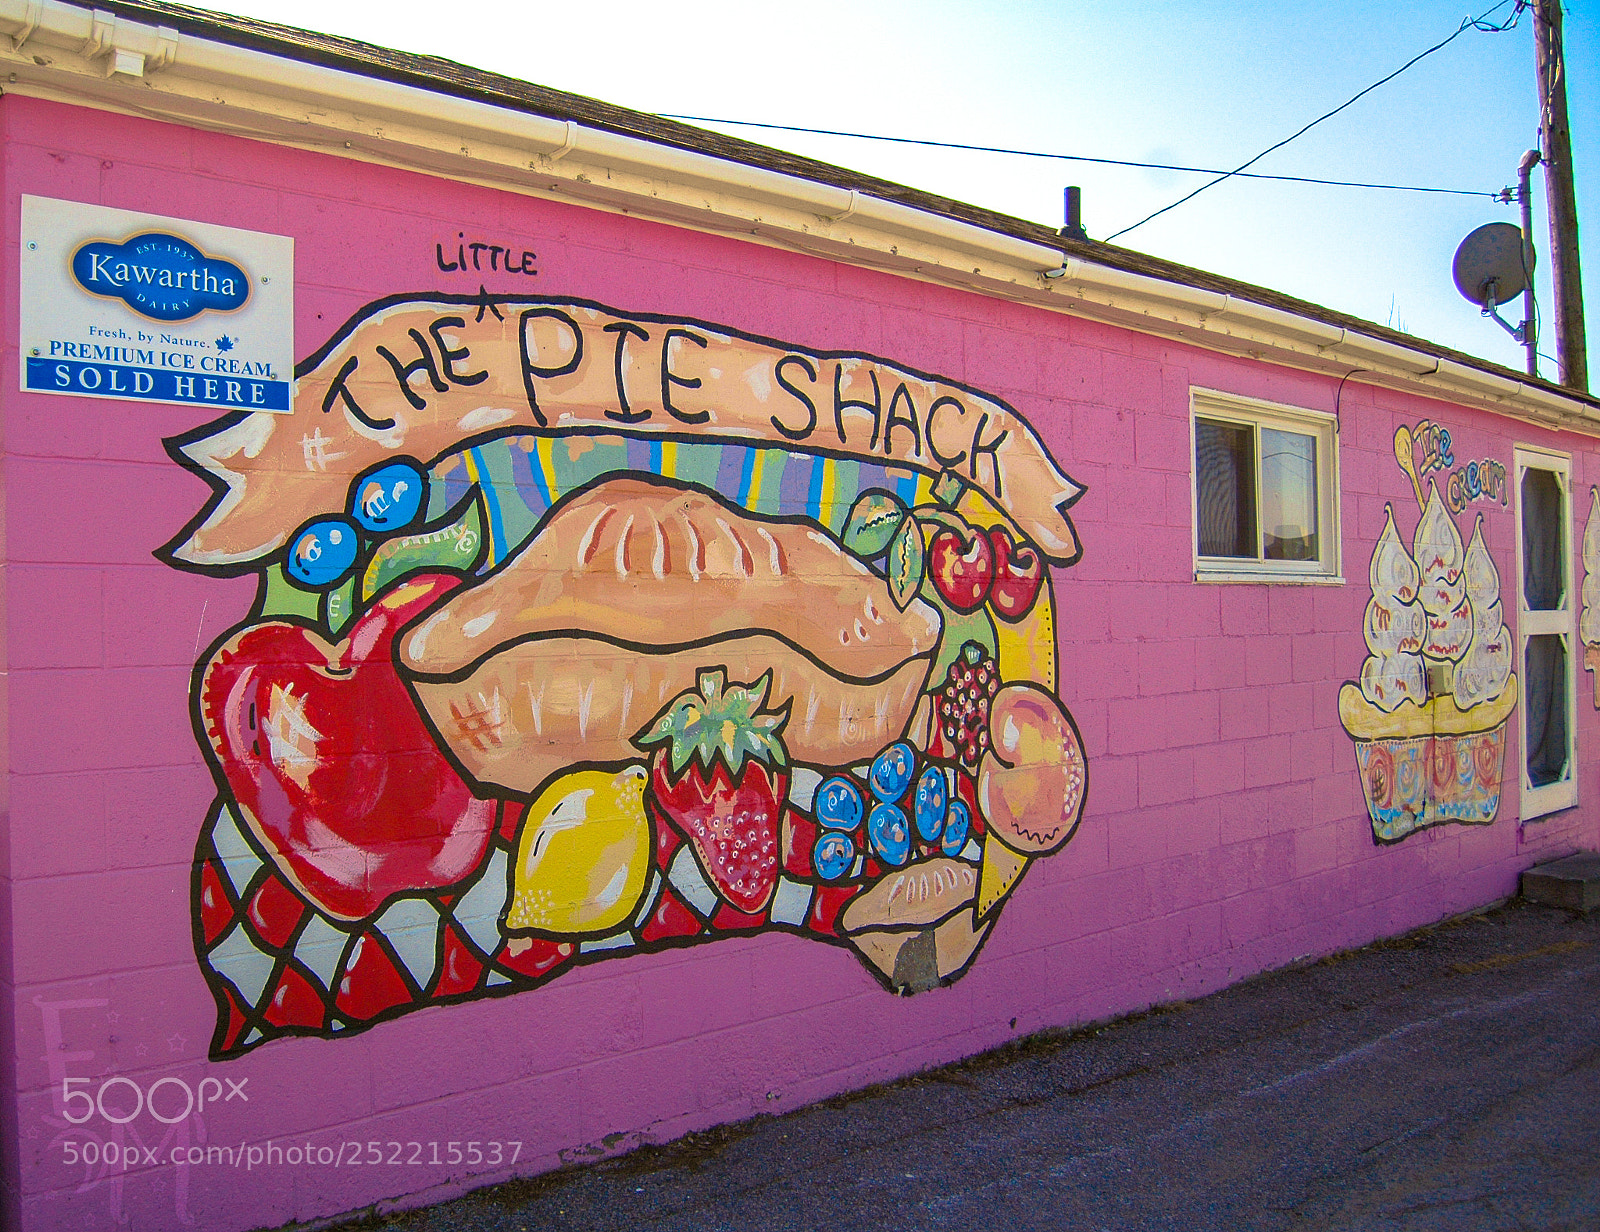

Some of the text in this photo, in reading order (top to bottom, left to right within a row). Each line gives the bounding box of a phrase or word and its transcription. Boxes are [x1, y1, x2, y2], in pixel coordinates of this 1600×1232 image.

[135, 243, 195, 262] EST. 1937
[88, 252, 237, 296] Kawartha
[136, 293, 191, 311] DAIRY
[88, 325, 211, 349] Fresh, by Nature.
[49, 339, 272, 378] PREMIUM ICE CREAM
[55, 364, 266, 404] SOLD HERE
[321, 306, 1009, 499] THE PIE SHACK
[1412, 418, 1455, 477] Ice
